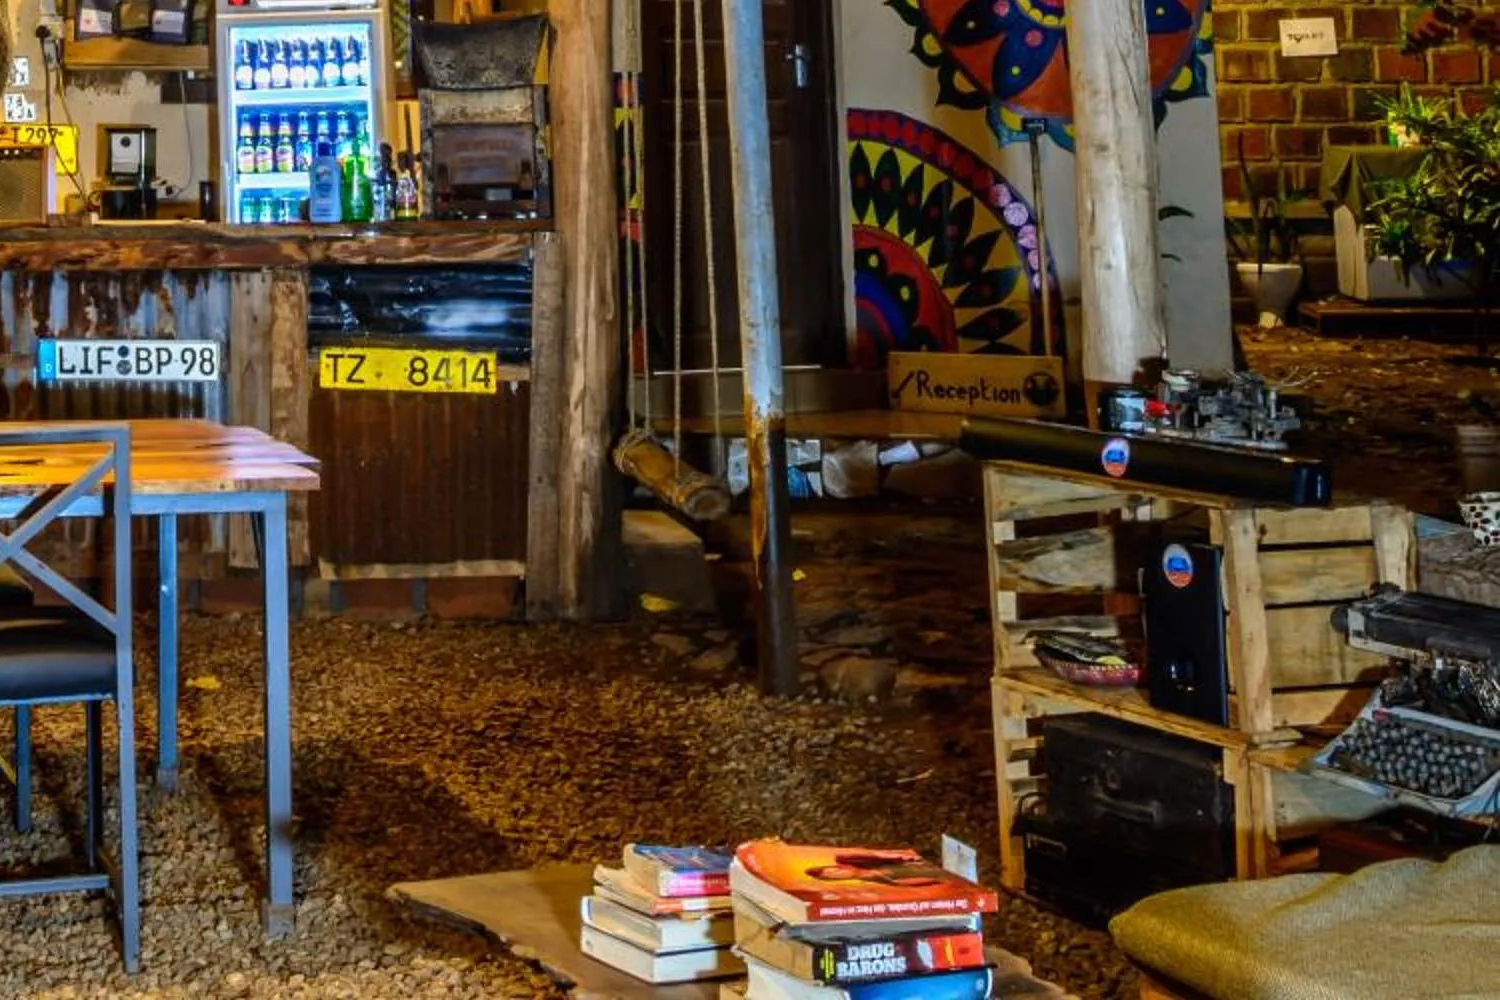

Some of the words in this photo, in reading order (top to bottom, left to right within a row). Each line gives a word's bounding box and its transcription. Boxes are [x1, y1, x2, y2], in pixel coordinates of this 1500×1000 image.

[58, 346, 115, 375] LIF
[135, 347, 173, 376] BP
[180, 347, 216, 376] 98
[325, 353, 367, 384] TZ
[407, 355, 492, 390] 8414
[916, 369, 1021, 409] Reception
[847, 942, 896, 961] DRUG
[835, 956, 908, 978] BARONS
